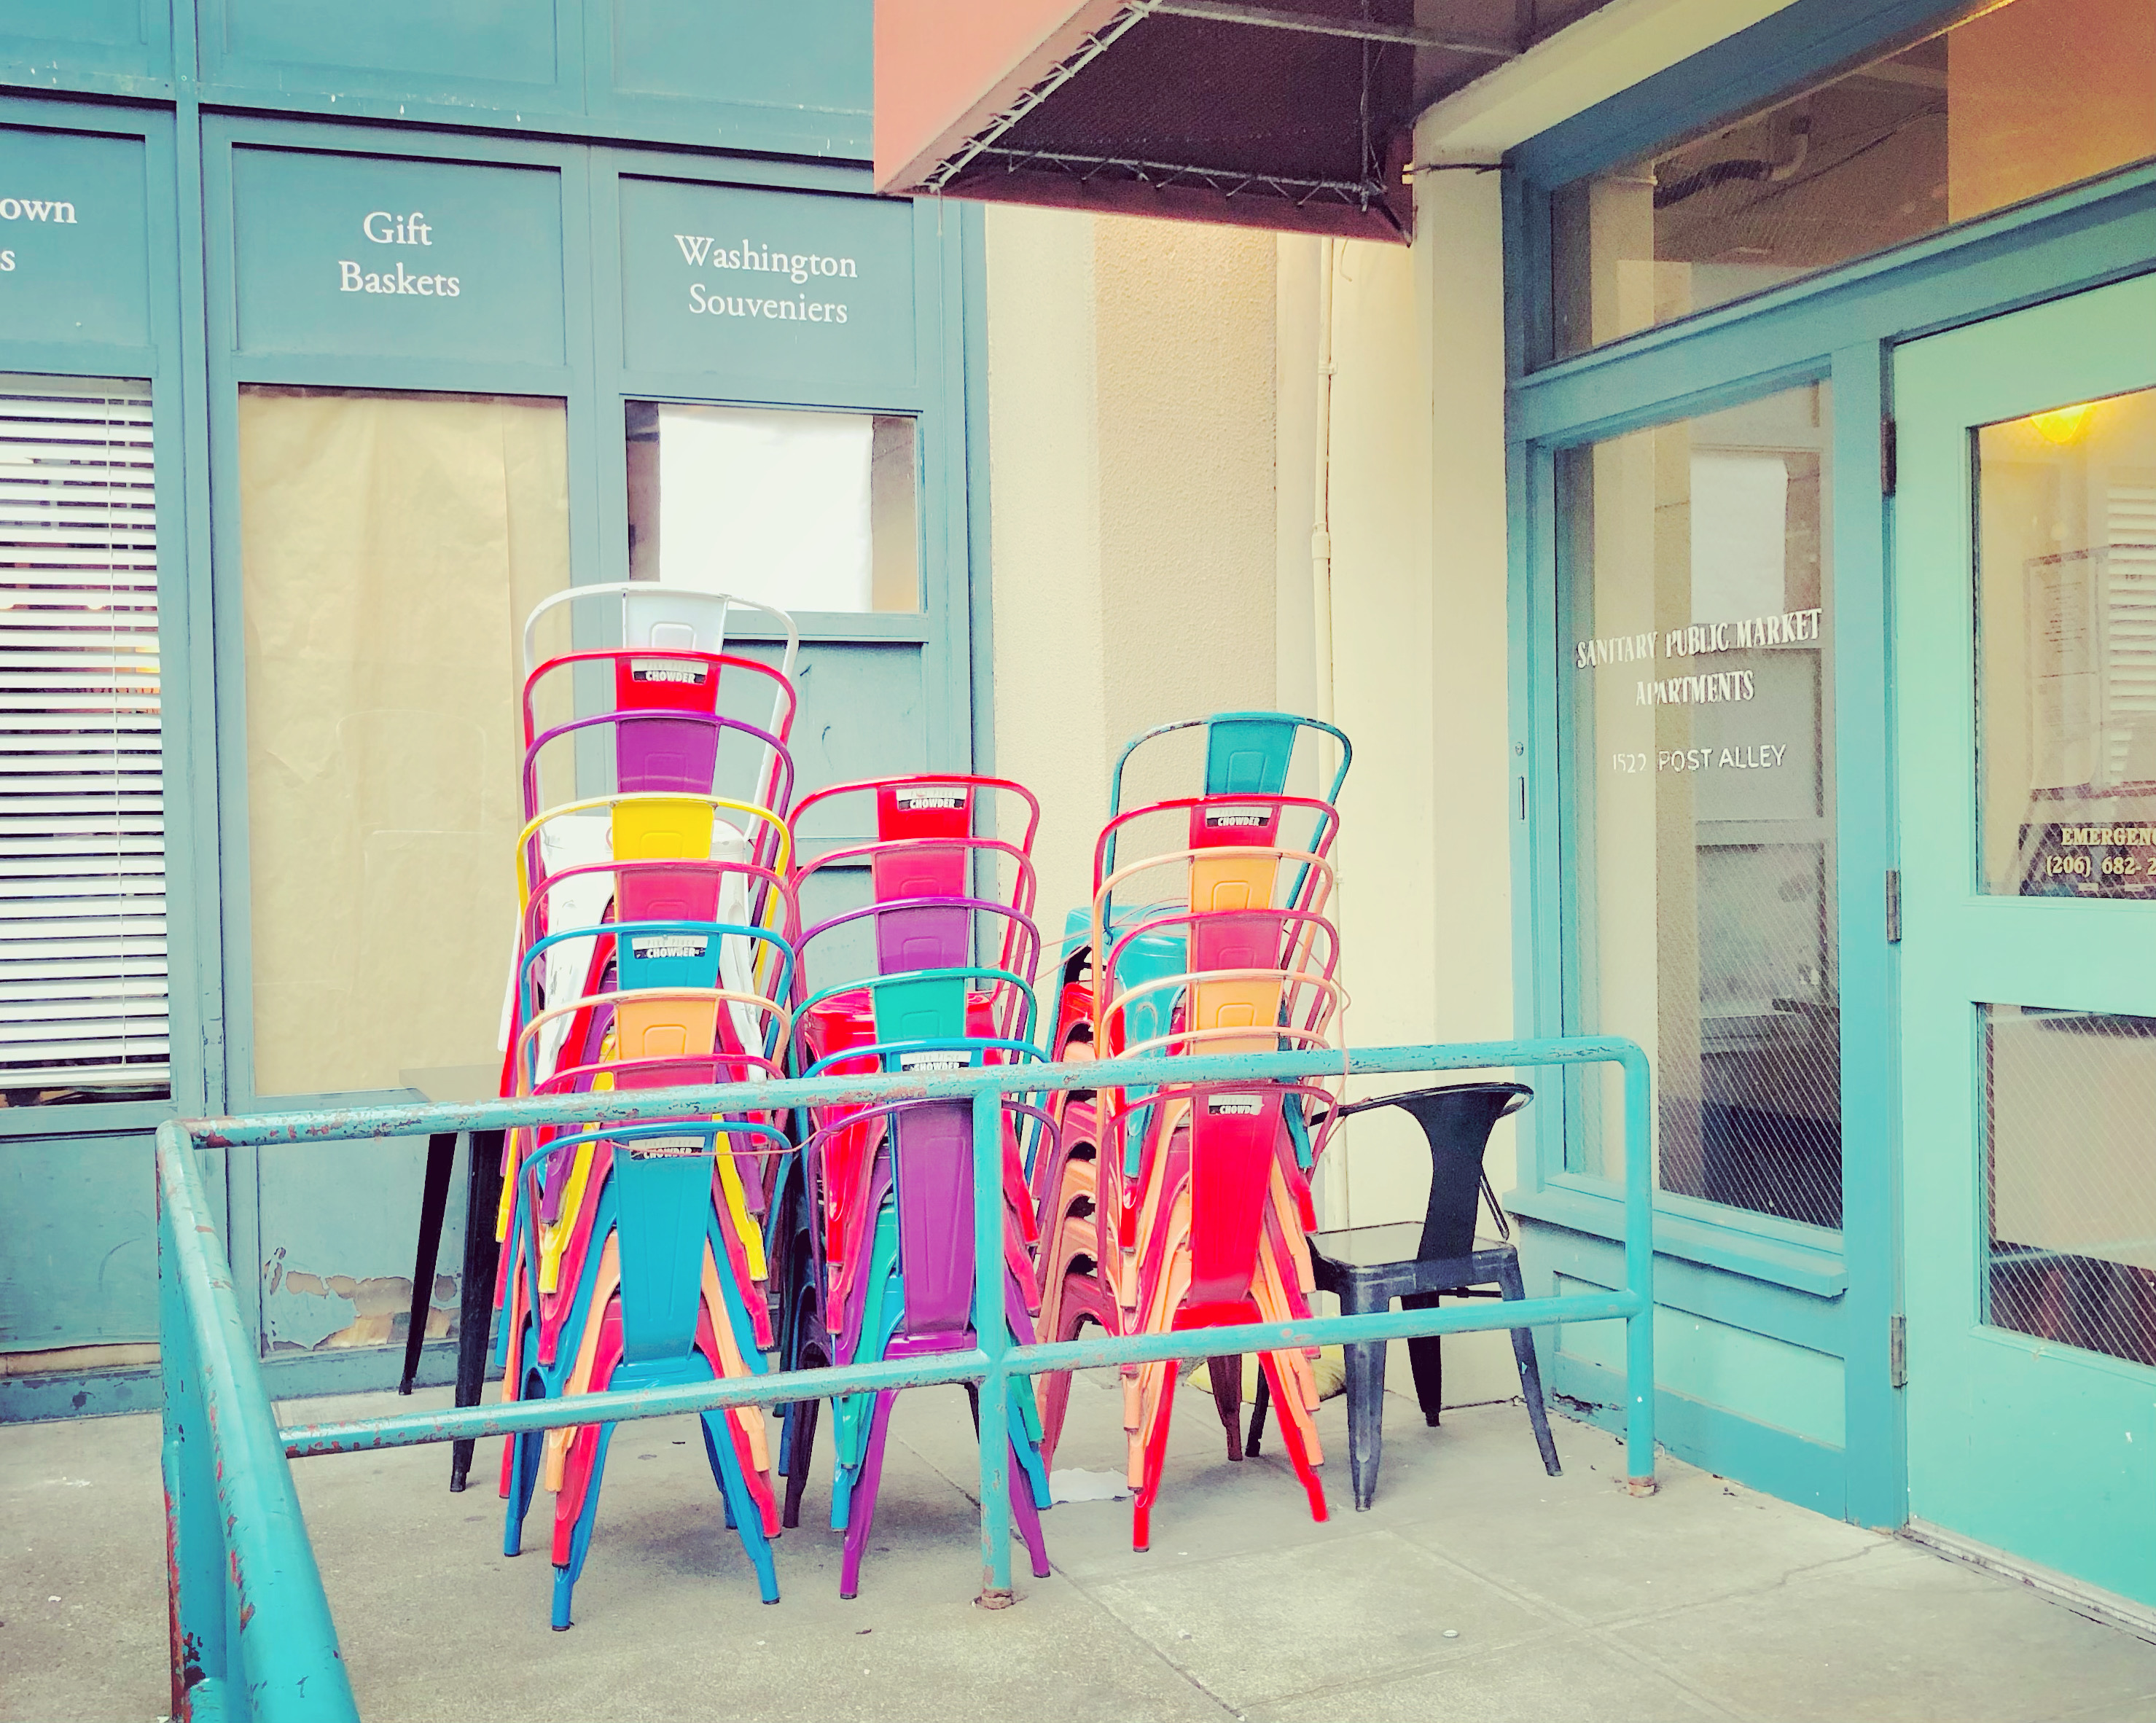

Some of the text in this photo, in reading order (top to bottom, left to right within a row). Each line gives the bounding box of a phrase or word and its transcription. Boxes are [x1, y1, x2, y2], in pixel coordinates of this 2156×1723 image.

[0, 198, 78, 224] own
[364, 211, 432, 246] Gift
[674, 235, 858, 284] Washington
[338, 261, 460, 297] Baskets
[689, 284, 848, 323] Souveniers
[1576, 608, 1823, 668] SANITARY PUBLIC MARKET
[646, 671, 695, 684] CHOWDER
[1636, 668, 1754, 706] APARTMENTS
[1658, 748, 1713, 773] POST
[1717, 743, 1786, 770] ALLEY
[910, 798, 955, 809] CHOWDER
[1217, 816, 1260, 827] CHOWDER
[2046, 856, 2091, 878] (206)
[647, 947, 695, 958] CHOWDER
[1219, 1106, 1255, 1115] CHOWD
